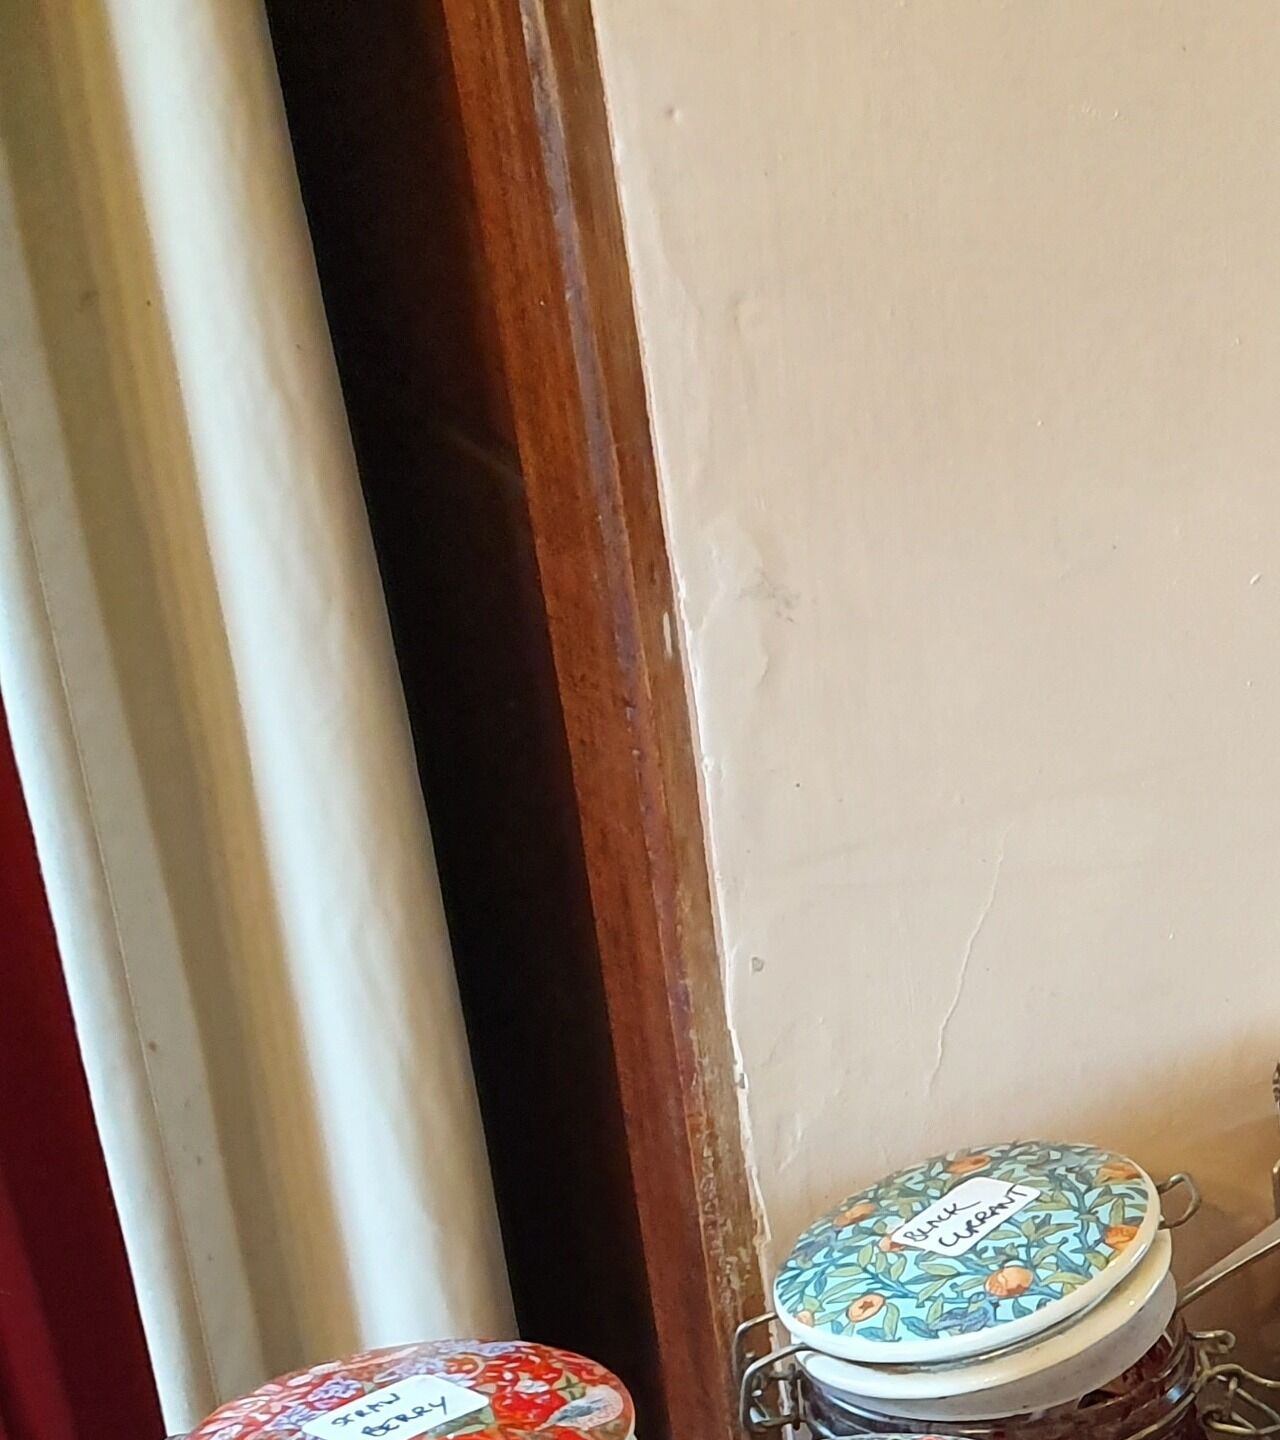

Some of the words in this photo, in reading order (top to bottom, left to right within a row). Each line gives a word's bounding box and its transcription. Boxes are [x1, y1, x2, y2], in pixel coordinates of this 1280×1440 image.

[903, 1201, 982, 1242] BLACK
[938, 1184, 1028, 1247] CURRANT
[361, 1395, 448, 1437] BERRY
